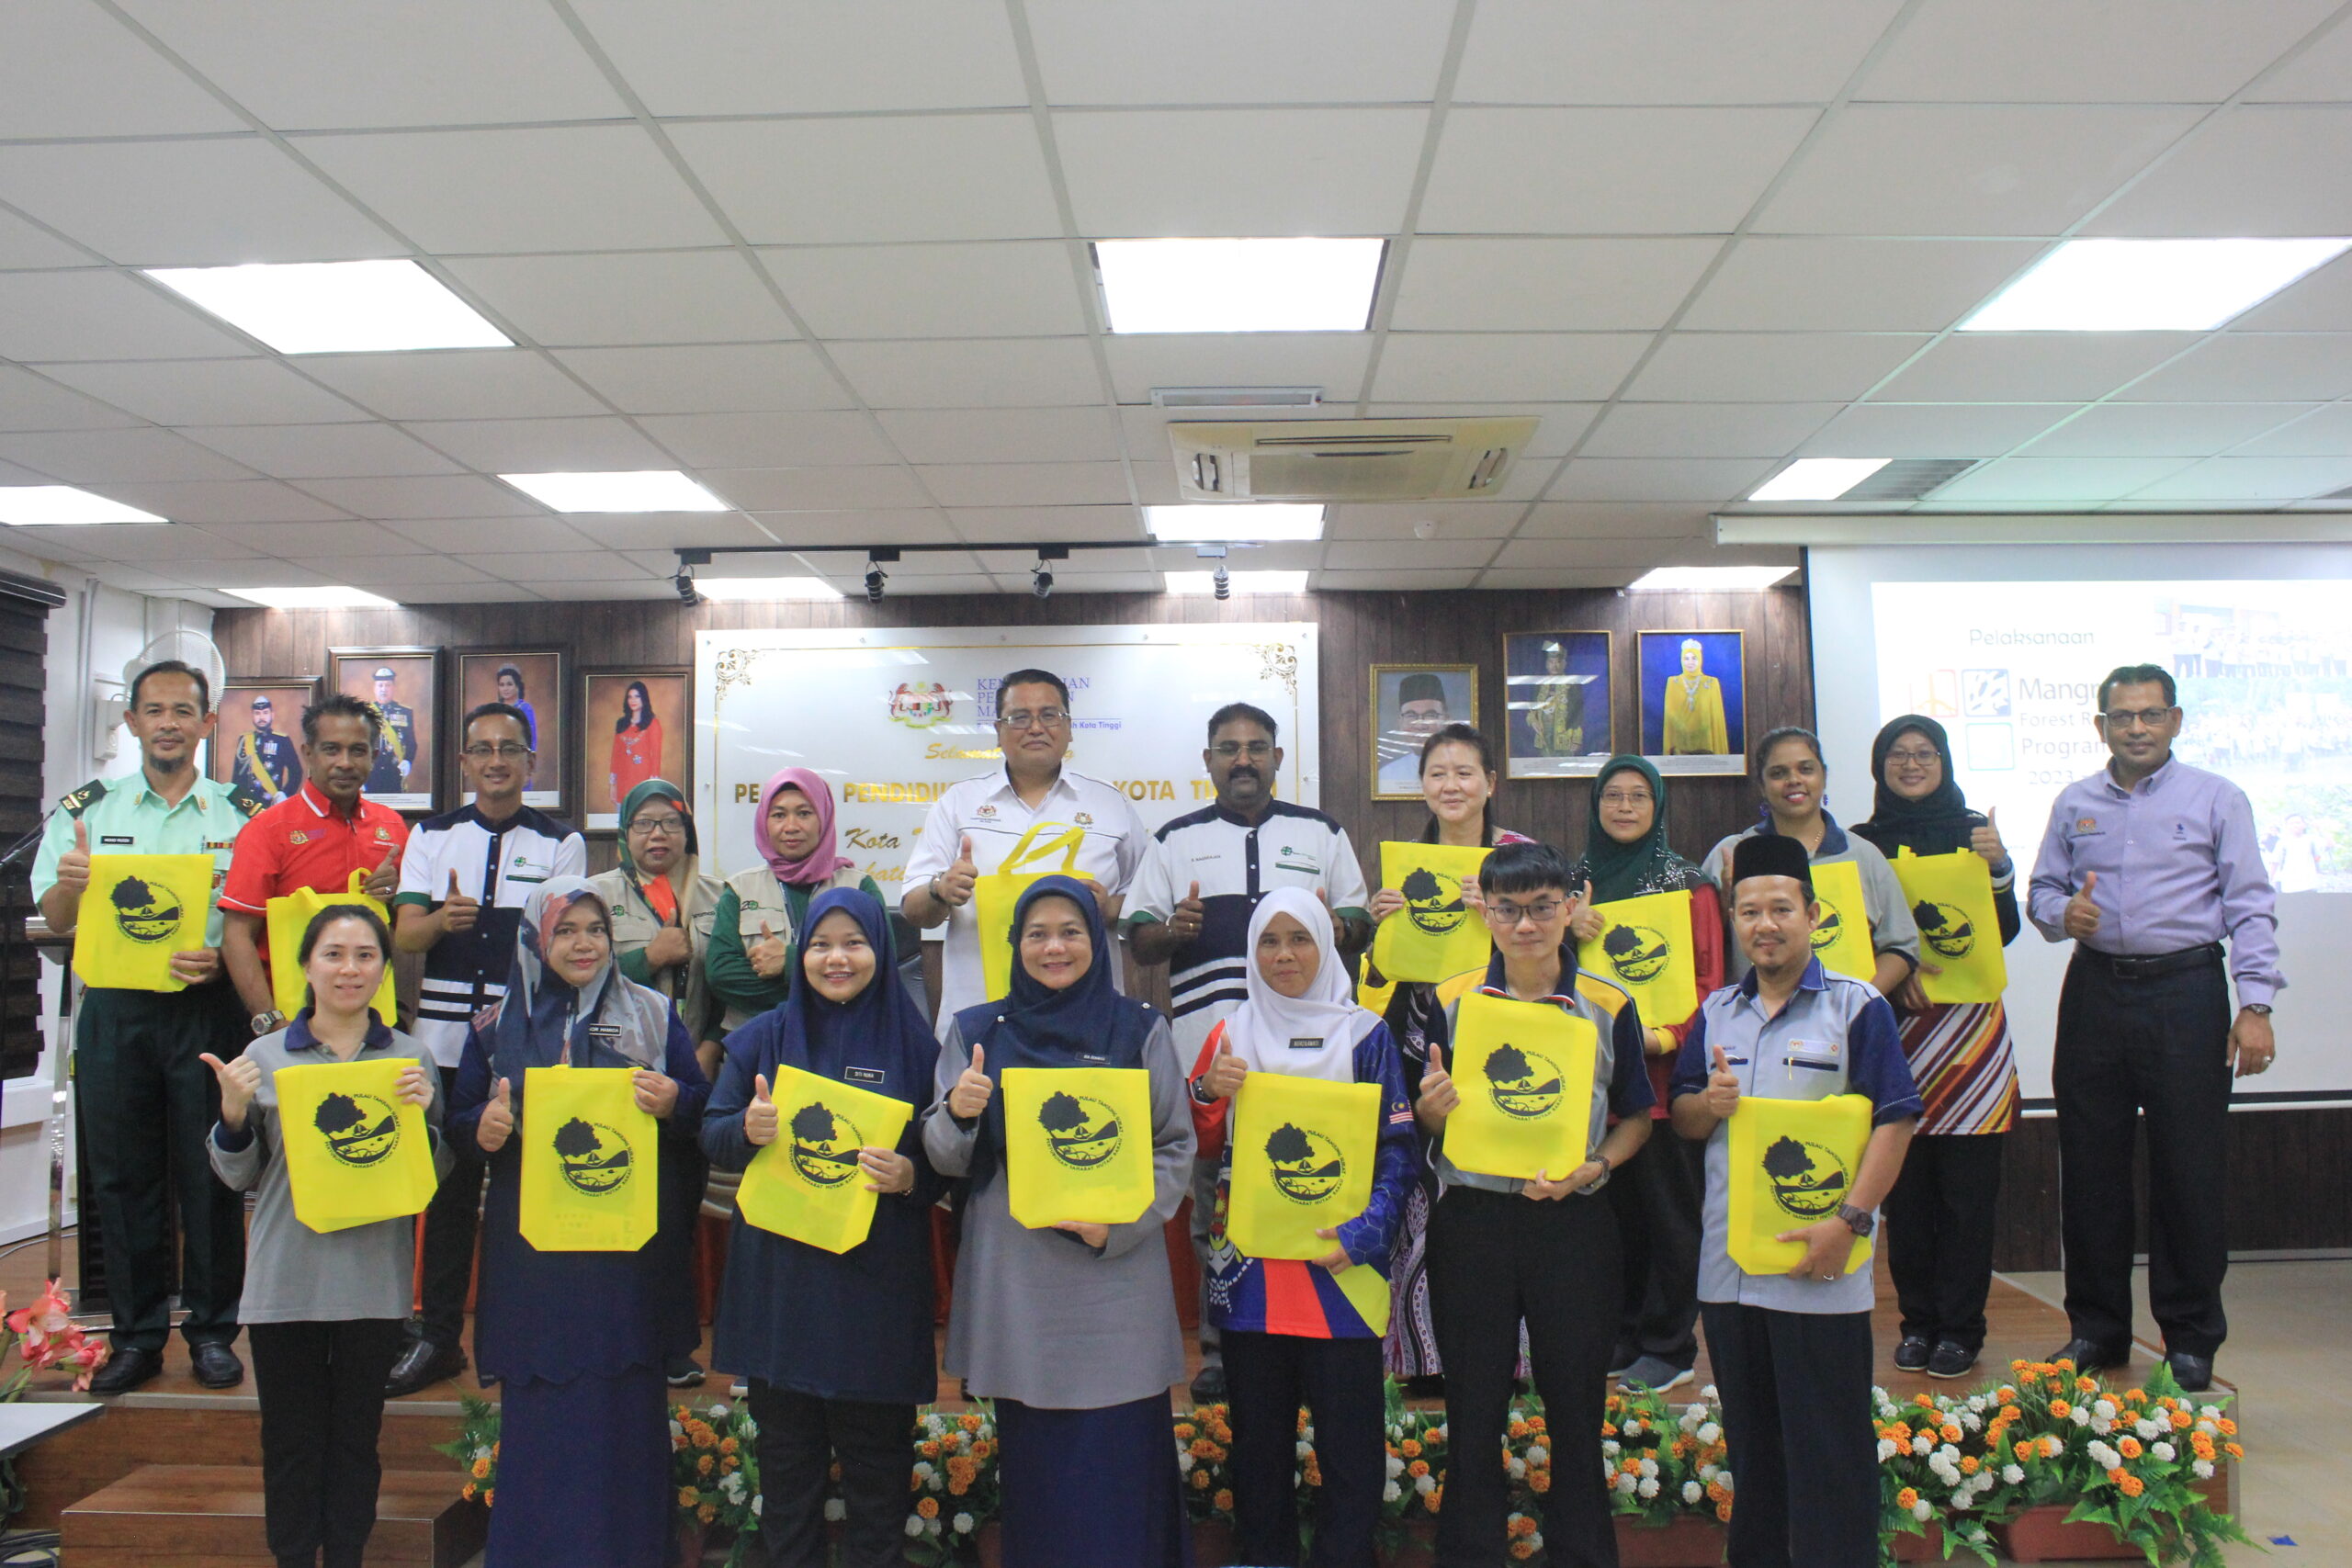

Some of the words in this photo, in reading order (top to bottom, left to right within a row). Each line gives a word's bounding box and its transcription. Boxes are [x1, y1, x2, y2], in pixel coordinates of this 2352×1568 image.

[1969, 628, 2095, 646] Pelaksanaan
[2018, 677, 2100, 705] Mangr
[1098, 721, 1122, 730] Tinggi
[2020, 713, 2075, 727] Forest
[844, 828, 901, 850] Kota
